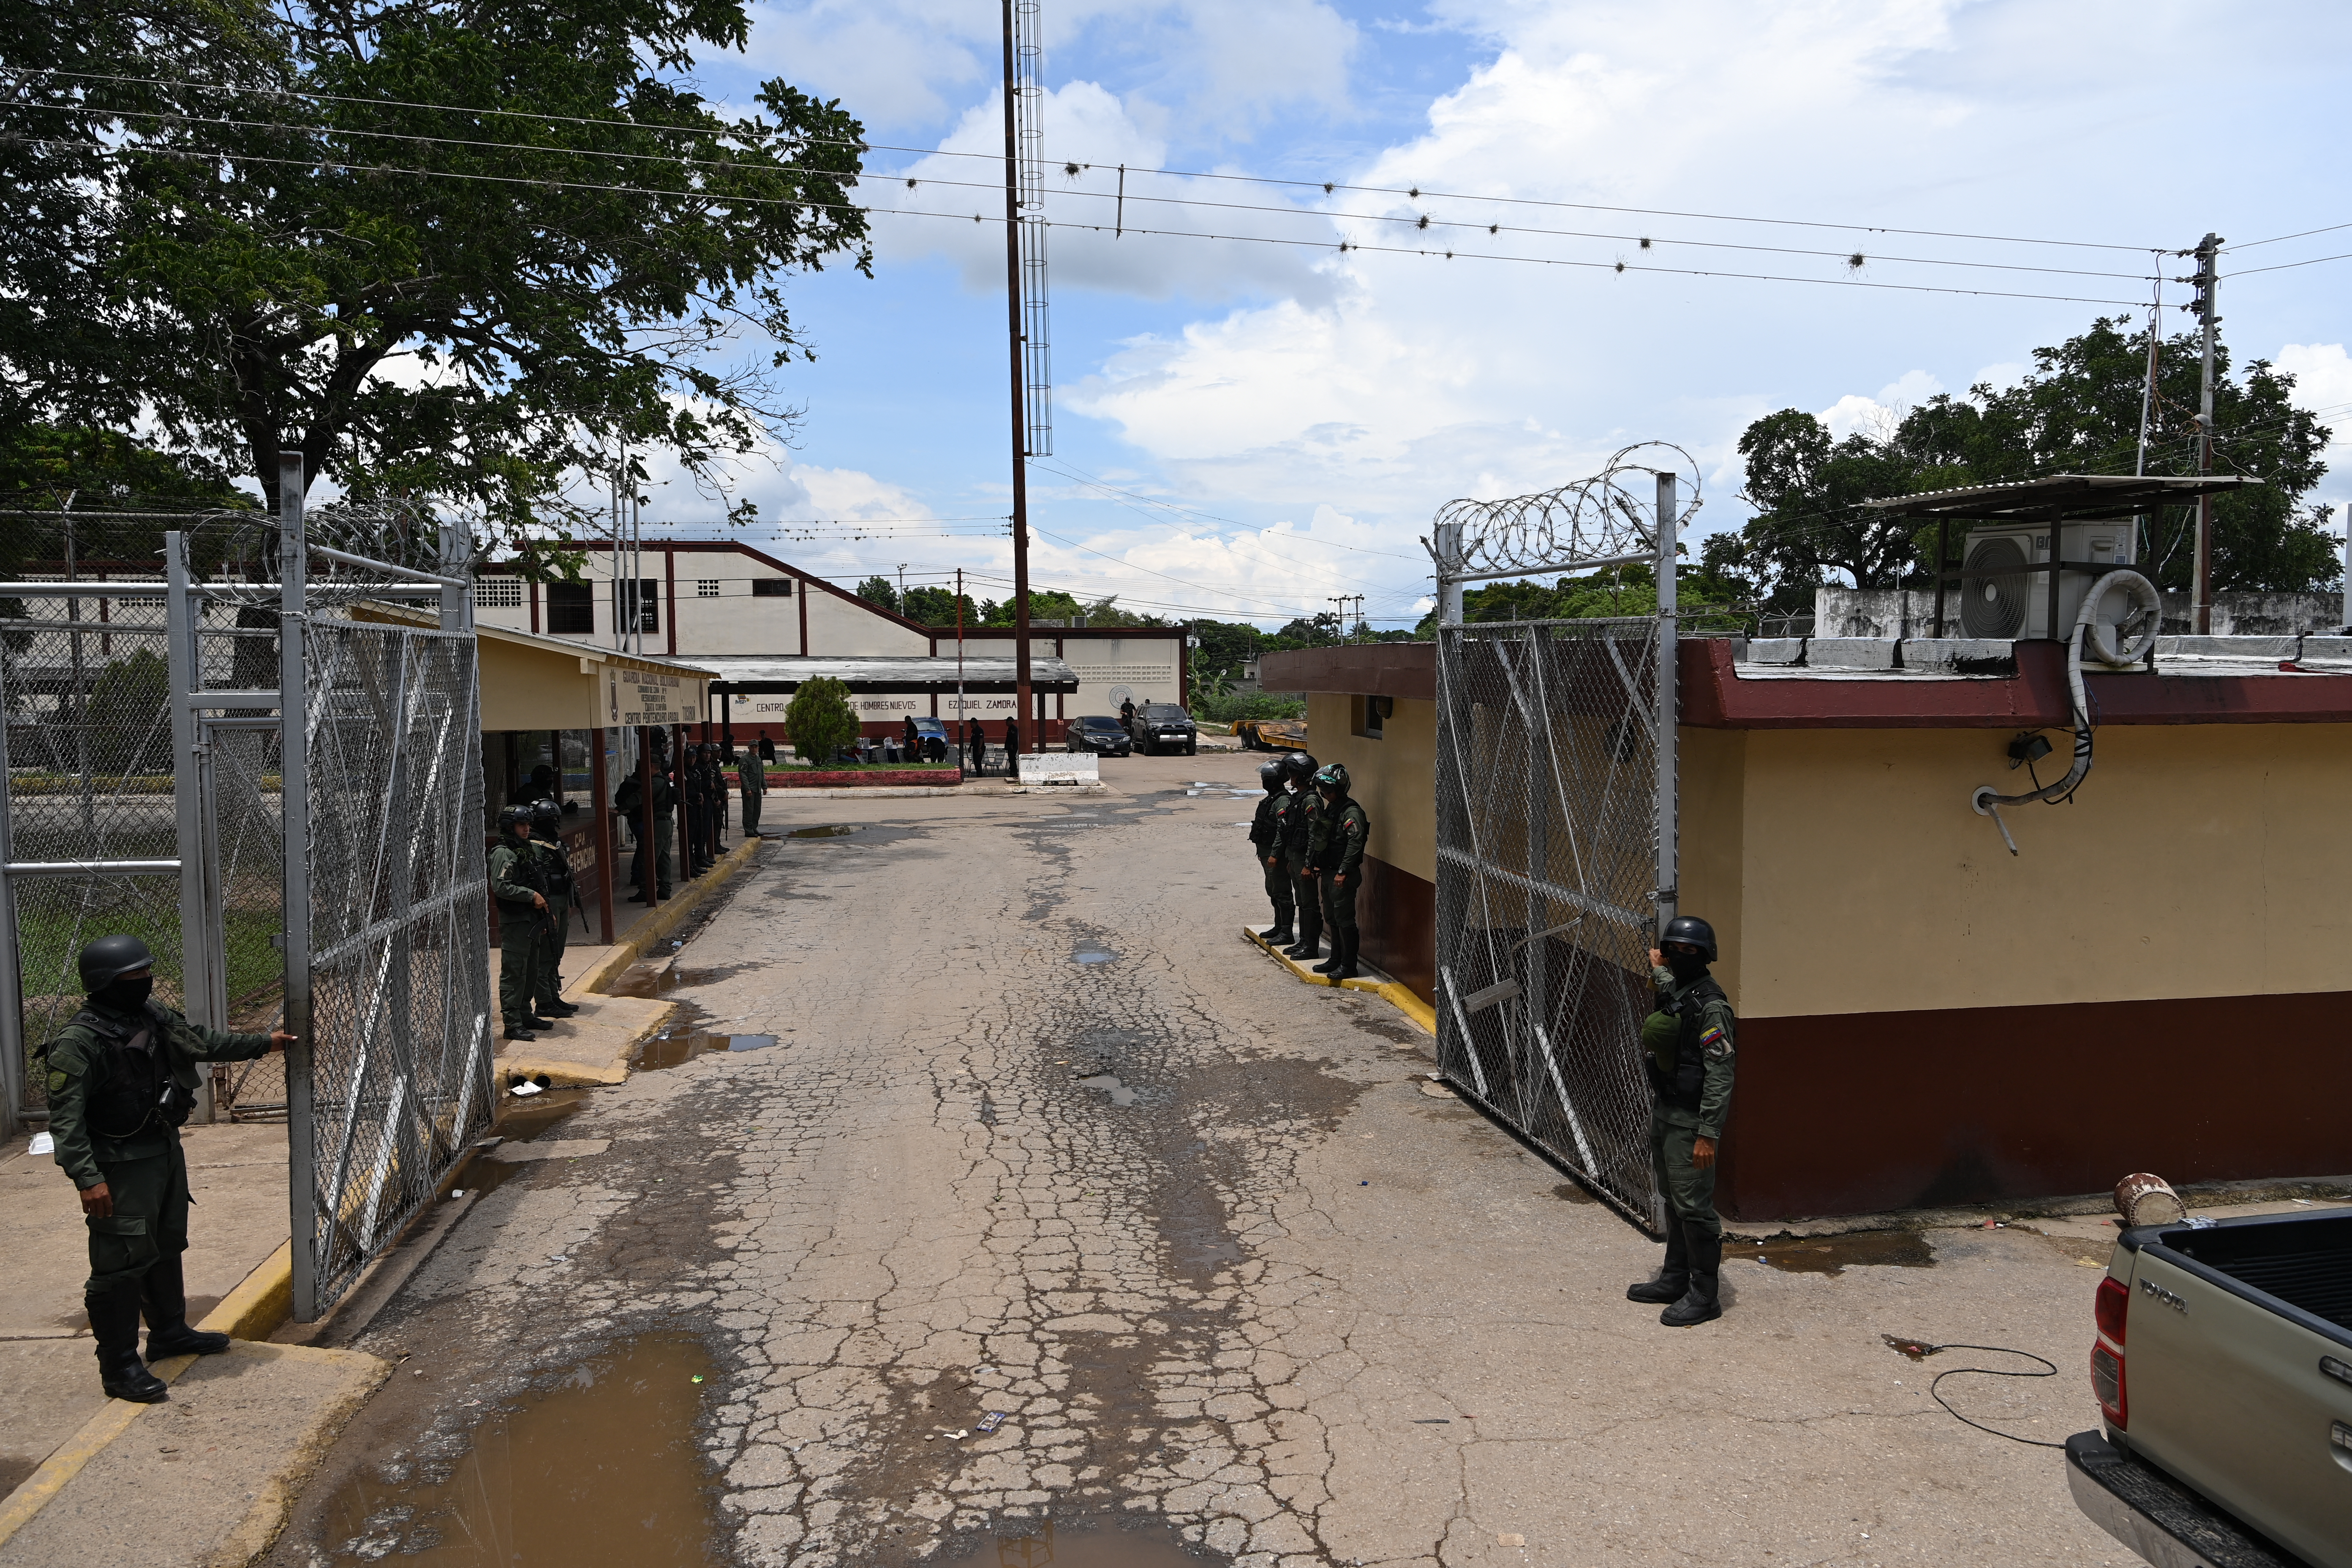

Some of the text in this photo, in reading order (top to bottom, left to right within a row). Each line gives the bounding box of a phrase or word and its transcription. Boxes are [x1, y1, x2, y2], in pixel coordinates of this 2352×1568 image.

[623, 670, 679, 688] GUARDIA NACIONAL BOLIVARIANA
[757, 703, 784, 712] CENTRO
[850, 701, 858, 710] DE
[860, 701, 889, 710] HOMBRES
[890, 701, 916, 710] NUEVOS
[949, 700, 1017, 710] EZQUIEL ZAMORA
[625, 712, 641, 724] CENTRO
[642, 712, 667, 724] PENITENCIARIO
[2139, 1277, 2188, 1314] TOYOTA
